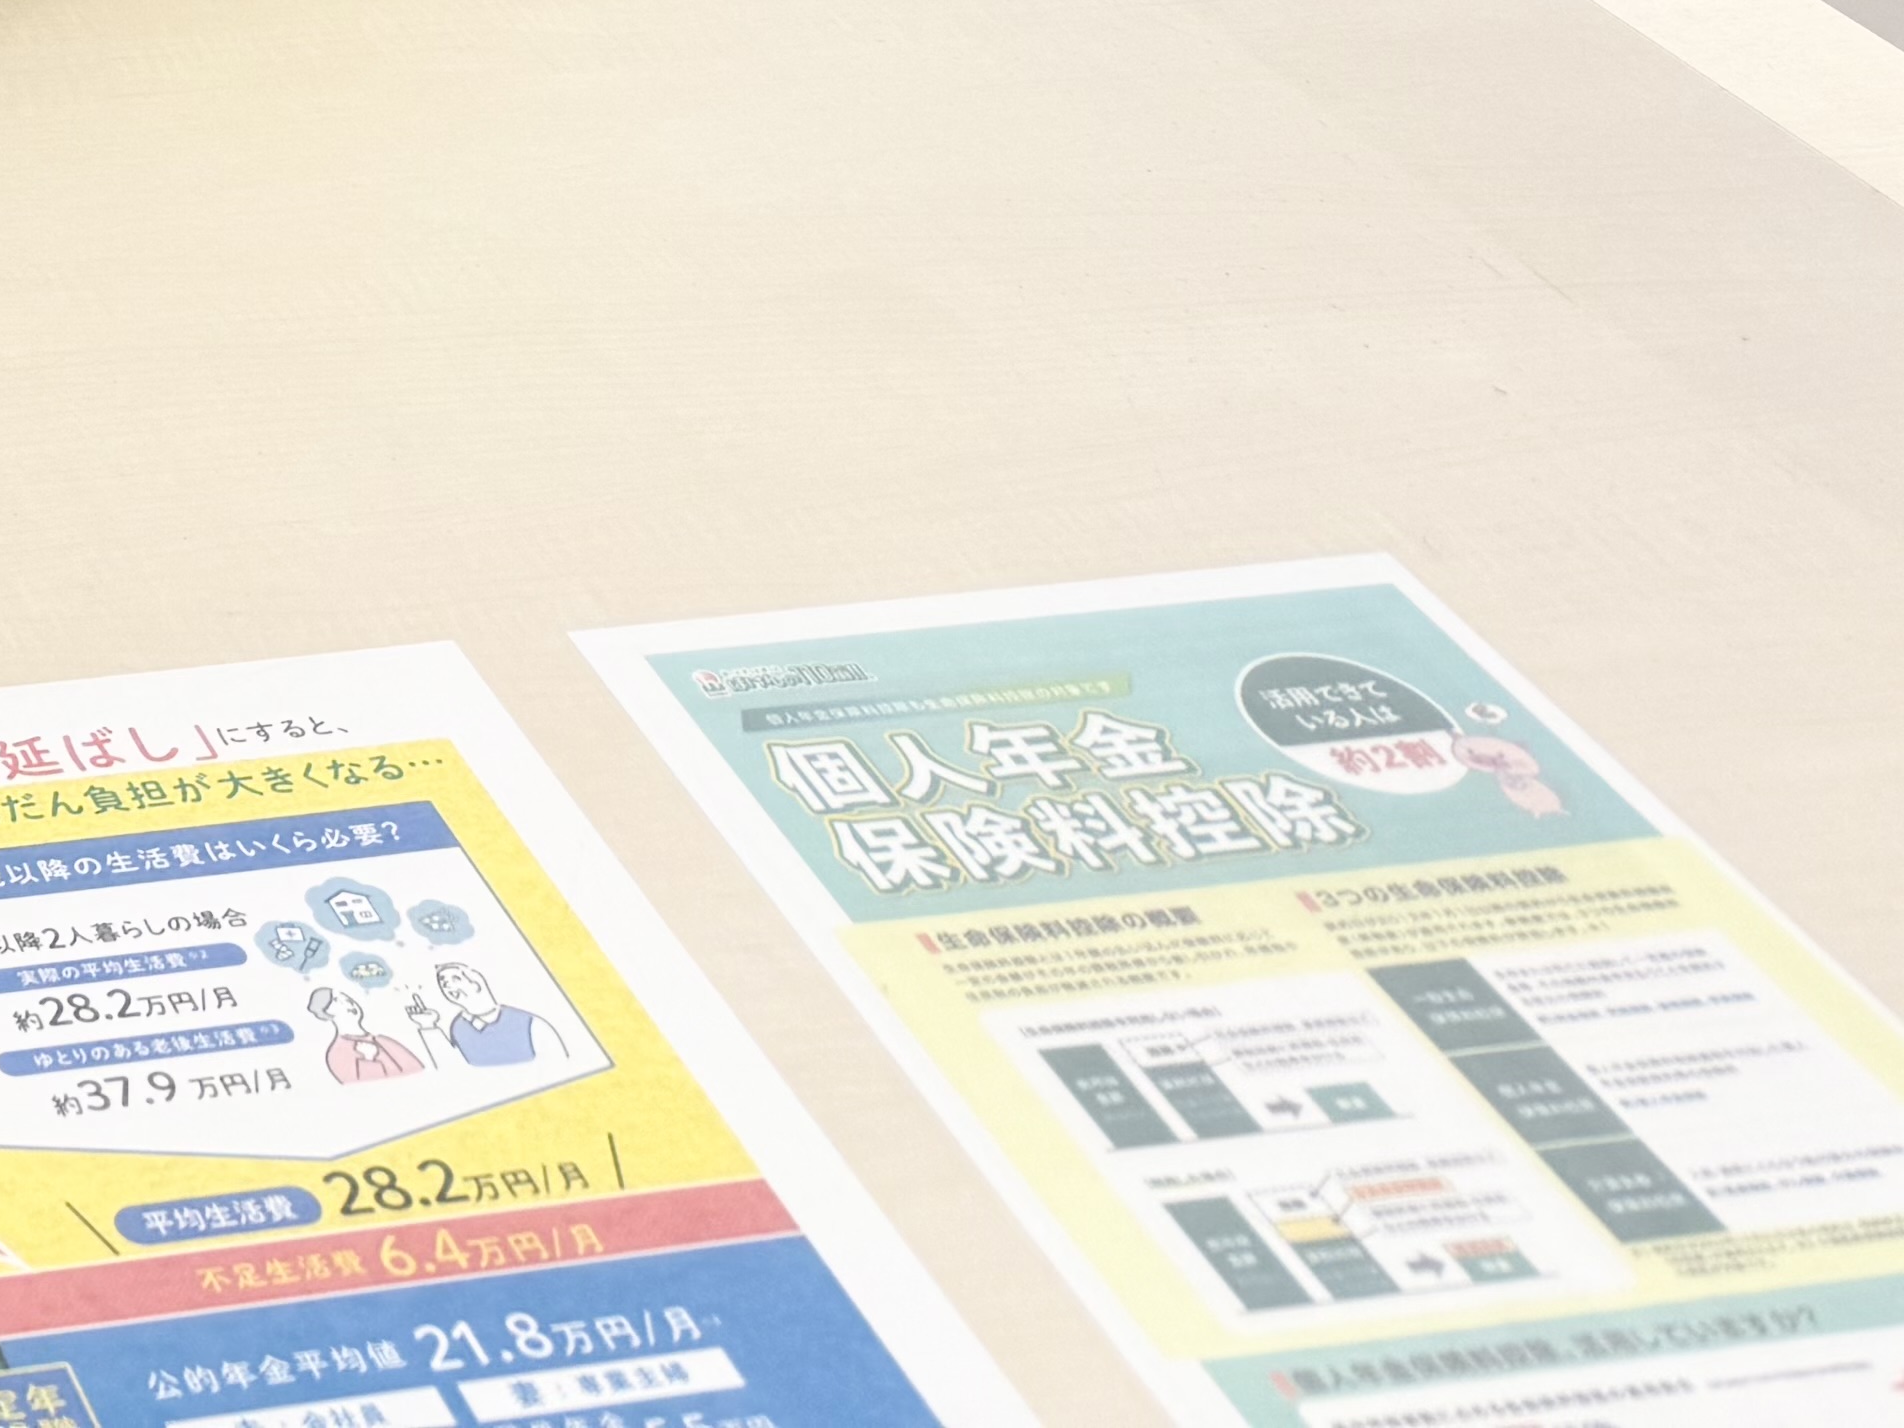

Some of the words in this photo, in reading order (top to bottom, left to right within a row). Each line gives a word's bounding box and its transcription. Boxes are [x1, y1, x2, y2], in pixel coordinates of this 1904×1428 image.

[1259, 679, 1388, 710] 活用できて
[1294, 704, 1402, 732] いる人は
[769, 710, 1195, 814] 個人年金
[1328, 737, 1448, 777] 約2割
[829, 773, 1366, 893] 保険料控除
[12, 985, 239, 1033] 約28.2万円/月
[140, 1191, 300, 1236] 平均生活費
[322, 1154, 591, 1221] 28.2万円/月
[199, 1246, 369, 1294] 不足生活費
[379, 1222, 606, 1279] 6.4万円/月
[147, 1338, 409, 1402] 公的年金平均値
[412, 1304, 703, 1374] 21.8万円/月
